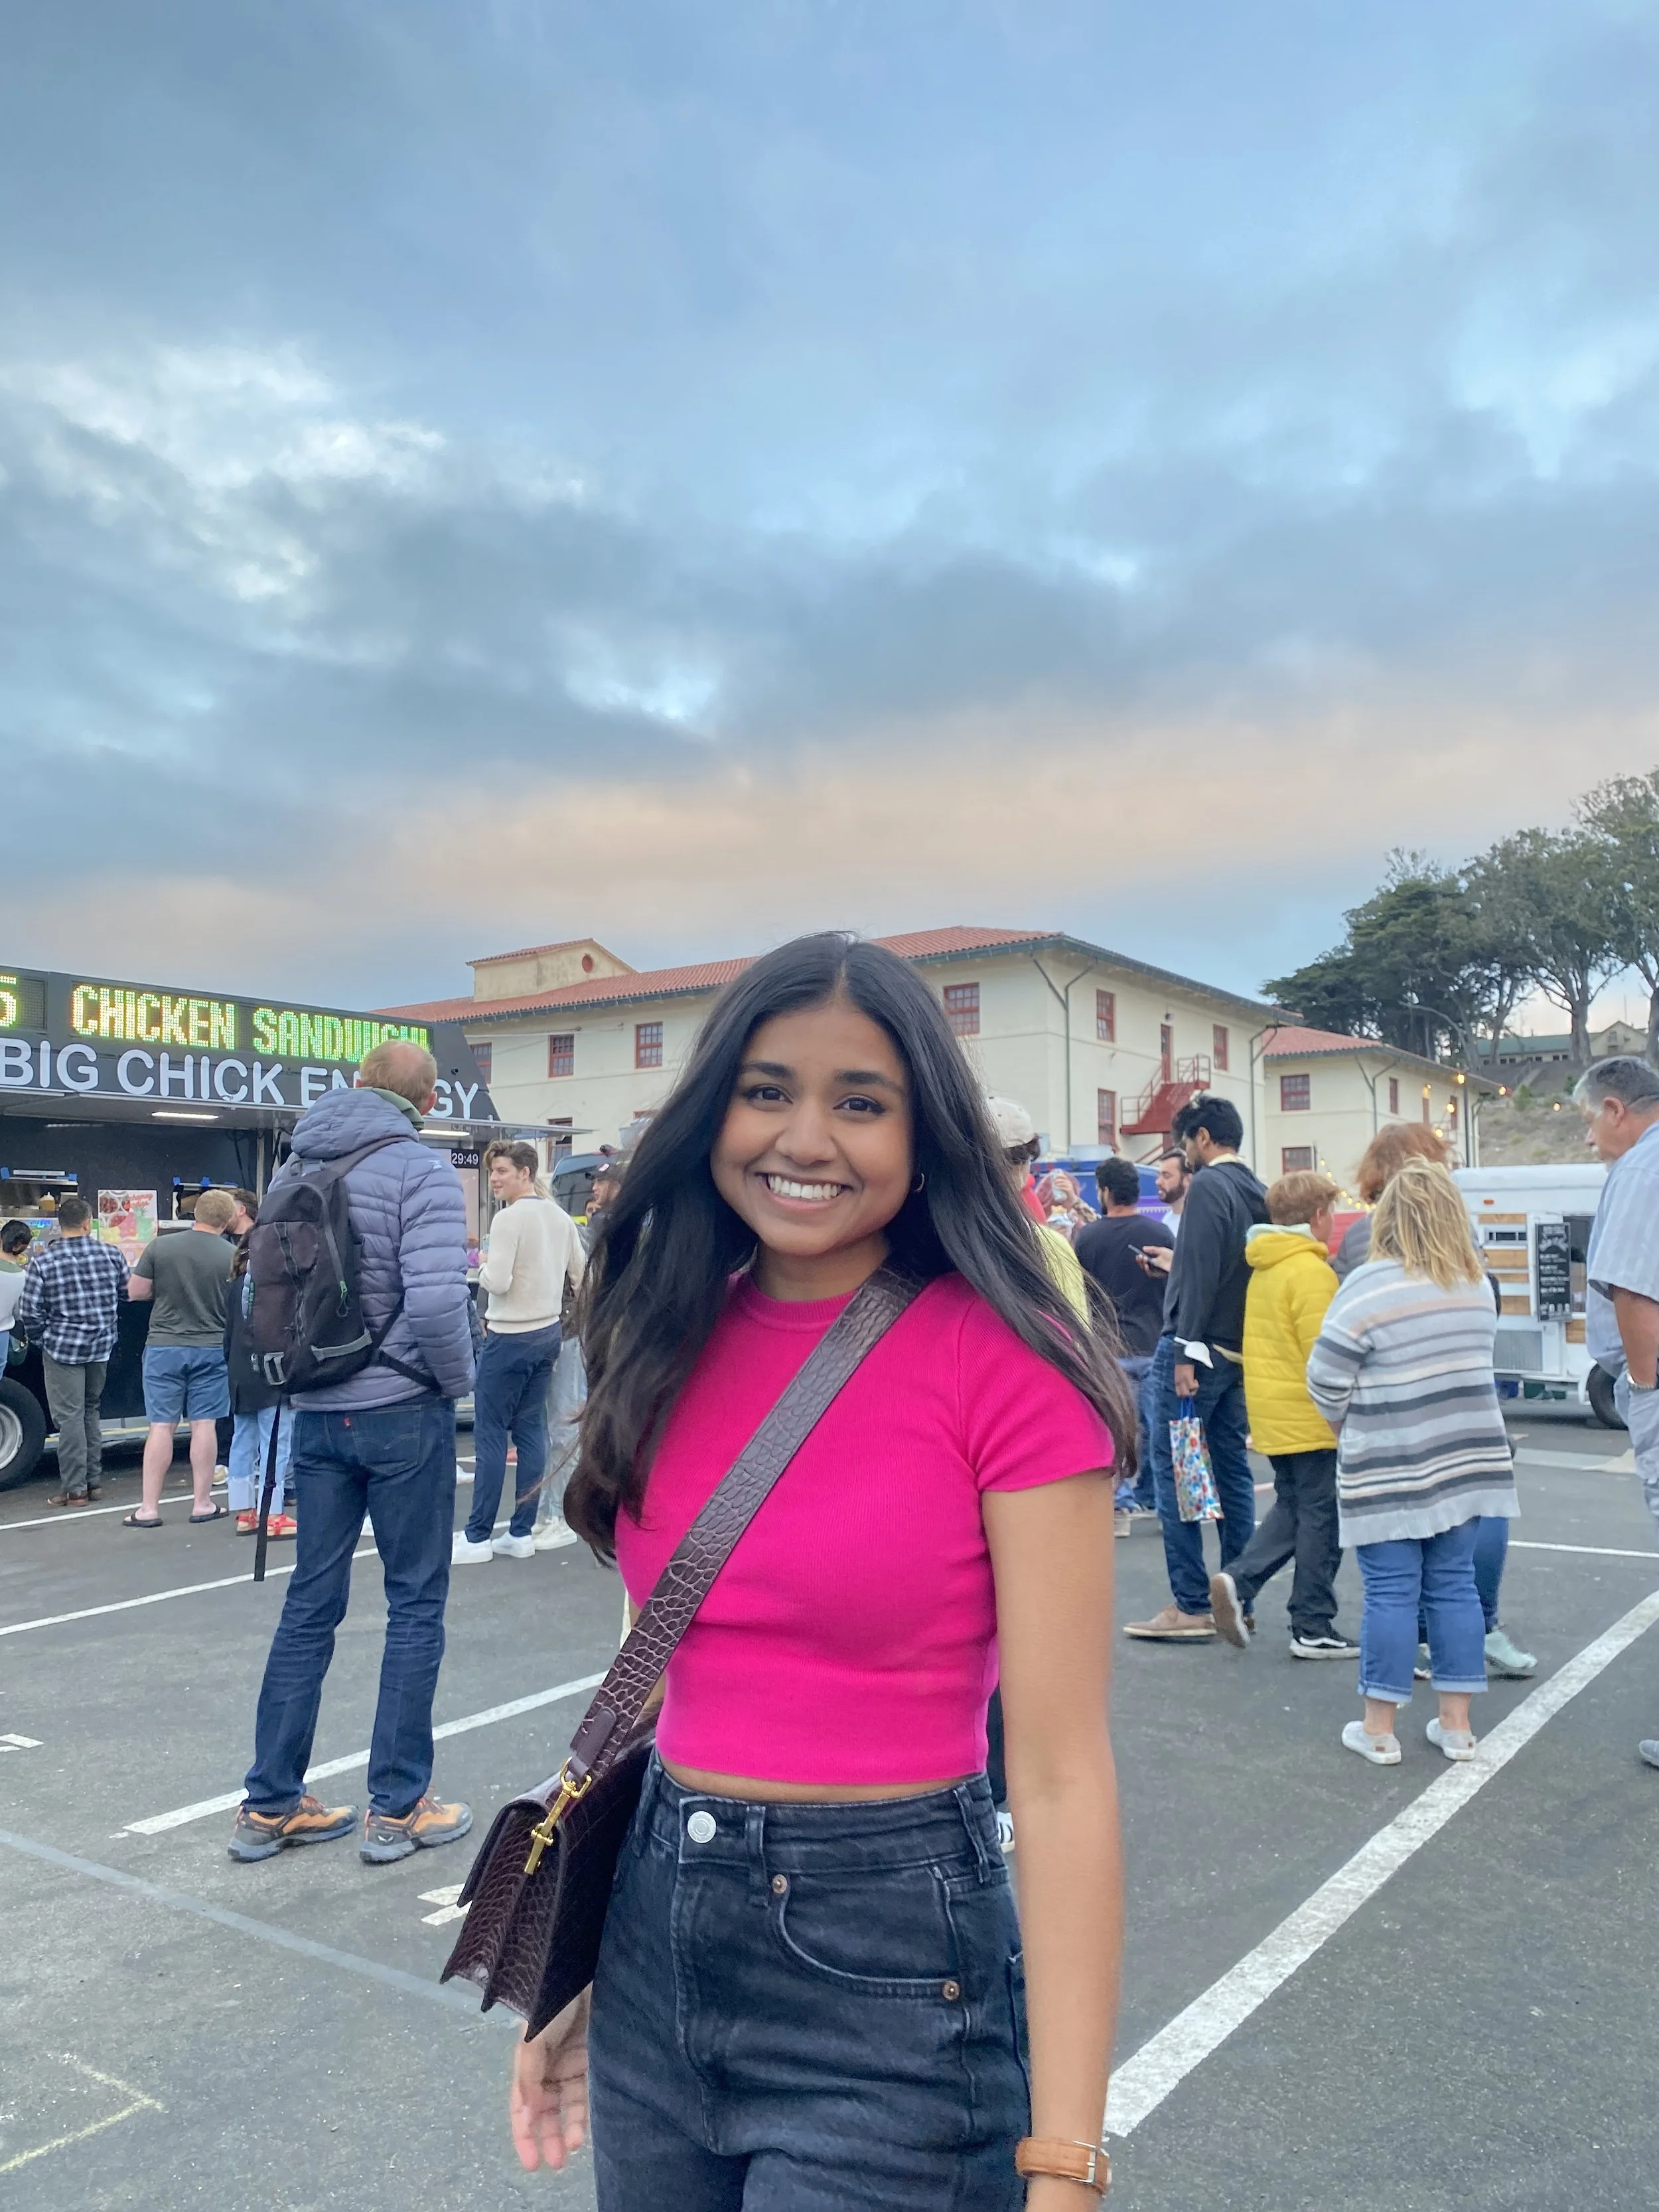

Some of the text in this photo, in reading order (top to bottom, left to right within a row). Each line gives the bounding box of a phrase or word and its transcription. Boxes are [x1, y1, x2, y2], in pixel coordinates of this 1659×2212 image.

[72, 985, 235, 1051] CHICKEN
[0, 1037, 478, 1120] BIG CHICK EGY
[451, 1152, 478, 1165] 29:49
